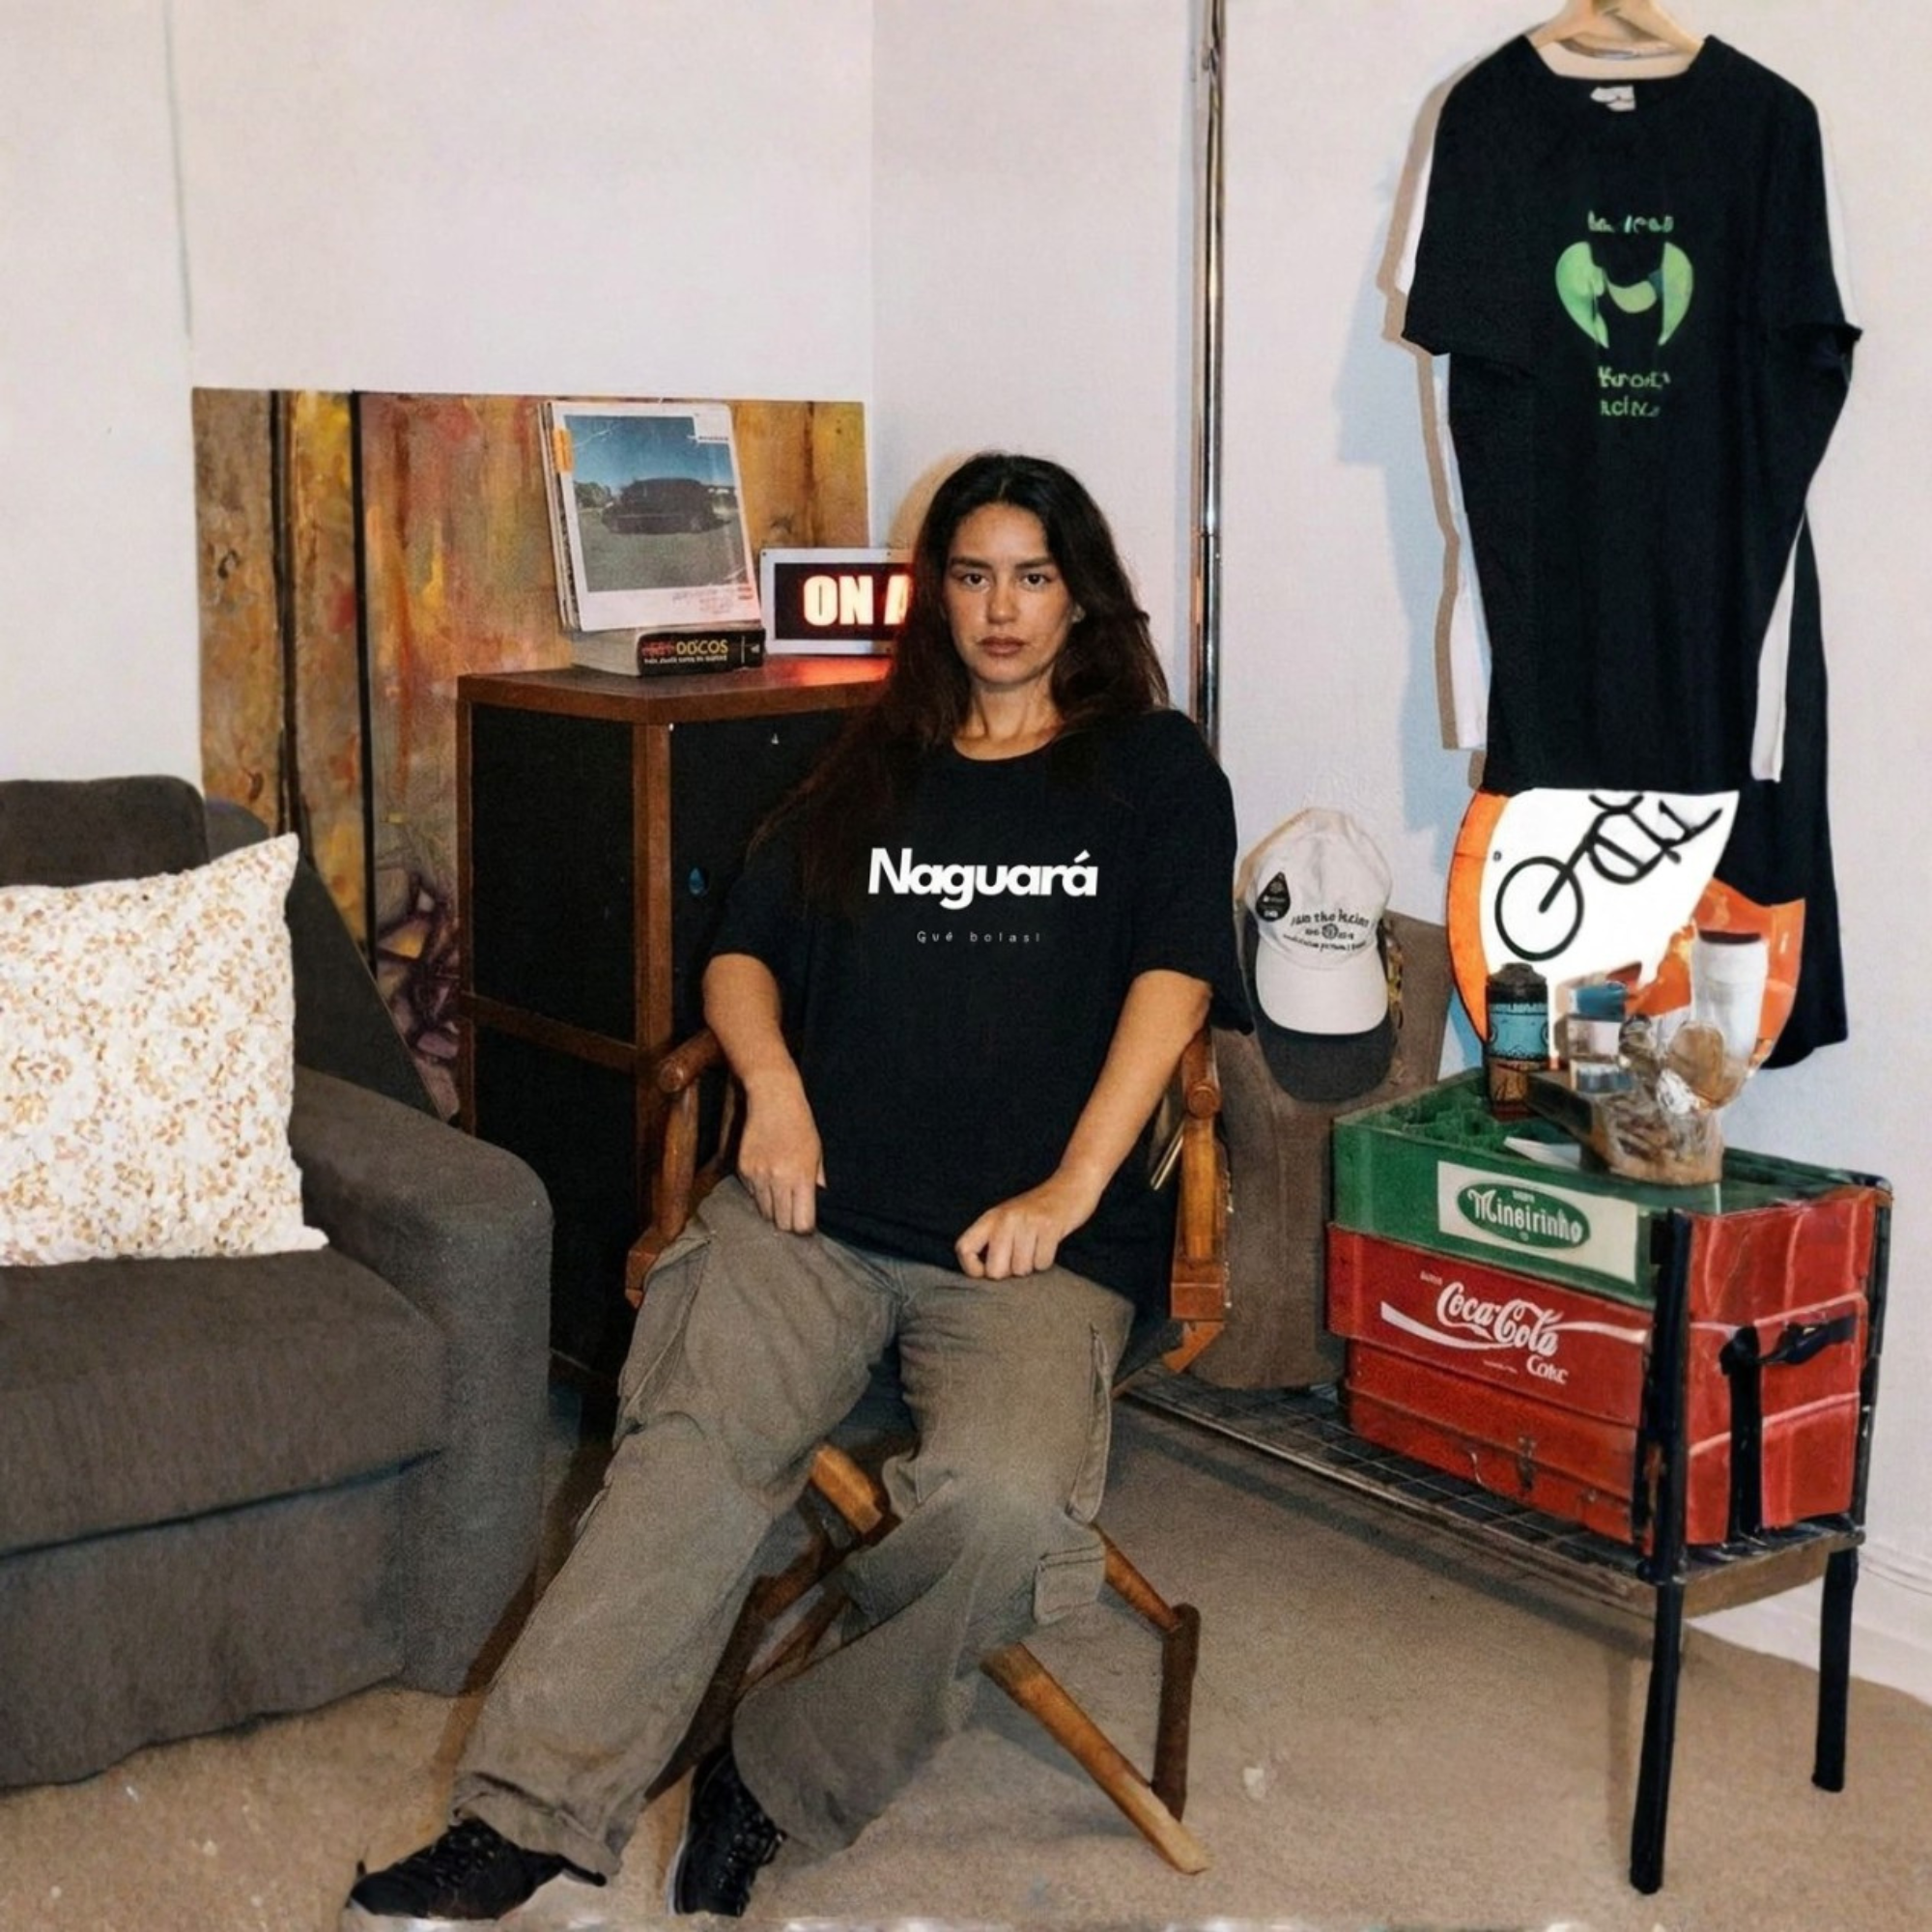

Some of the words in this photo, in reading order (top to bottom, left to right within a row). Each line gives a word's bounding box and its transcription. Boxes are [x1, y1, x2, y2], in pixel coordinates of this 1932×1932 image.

[804, 575, 873, 626] ON
[868, 847, 1098, 910] Naguará
[1467, 1189, 1583, 1243] Mineirinho
[1436, 1281, 1564, 1357] Coca-Cola
